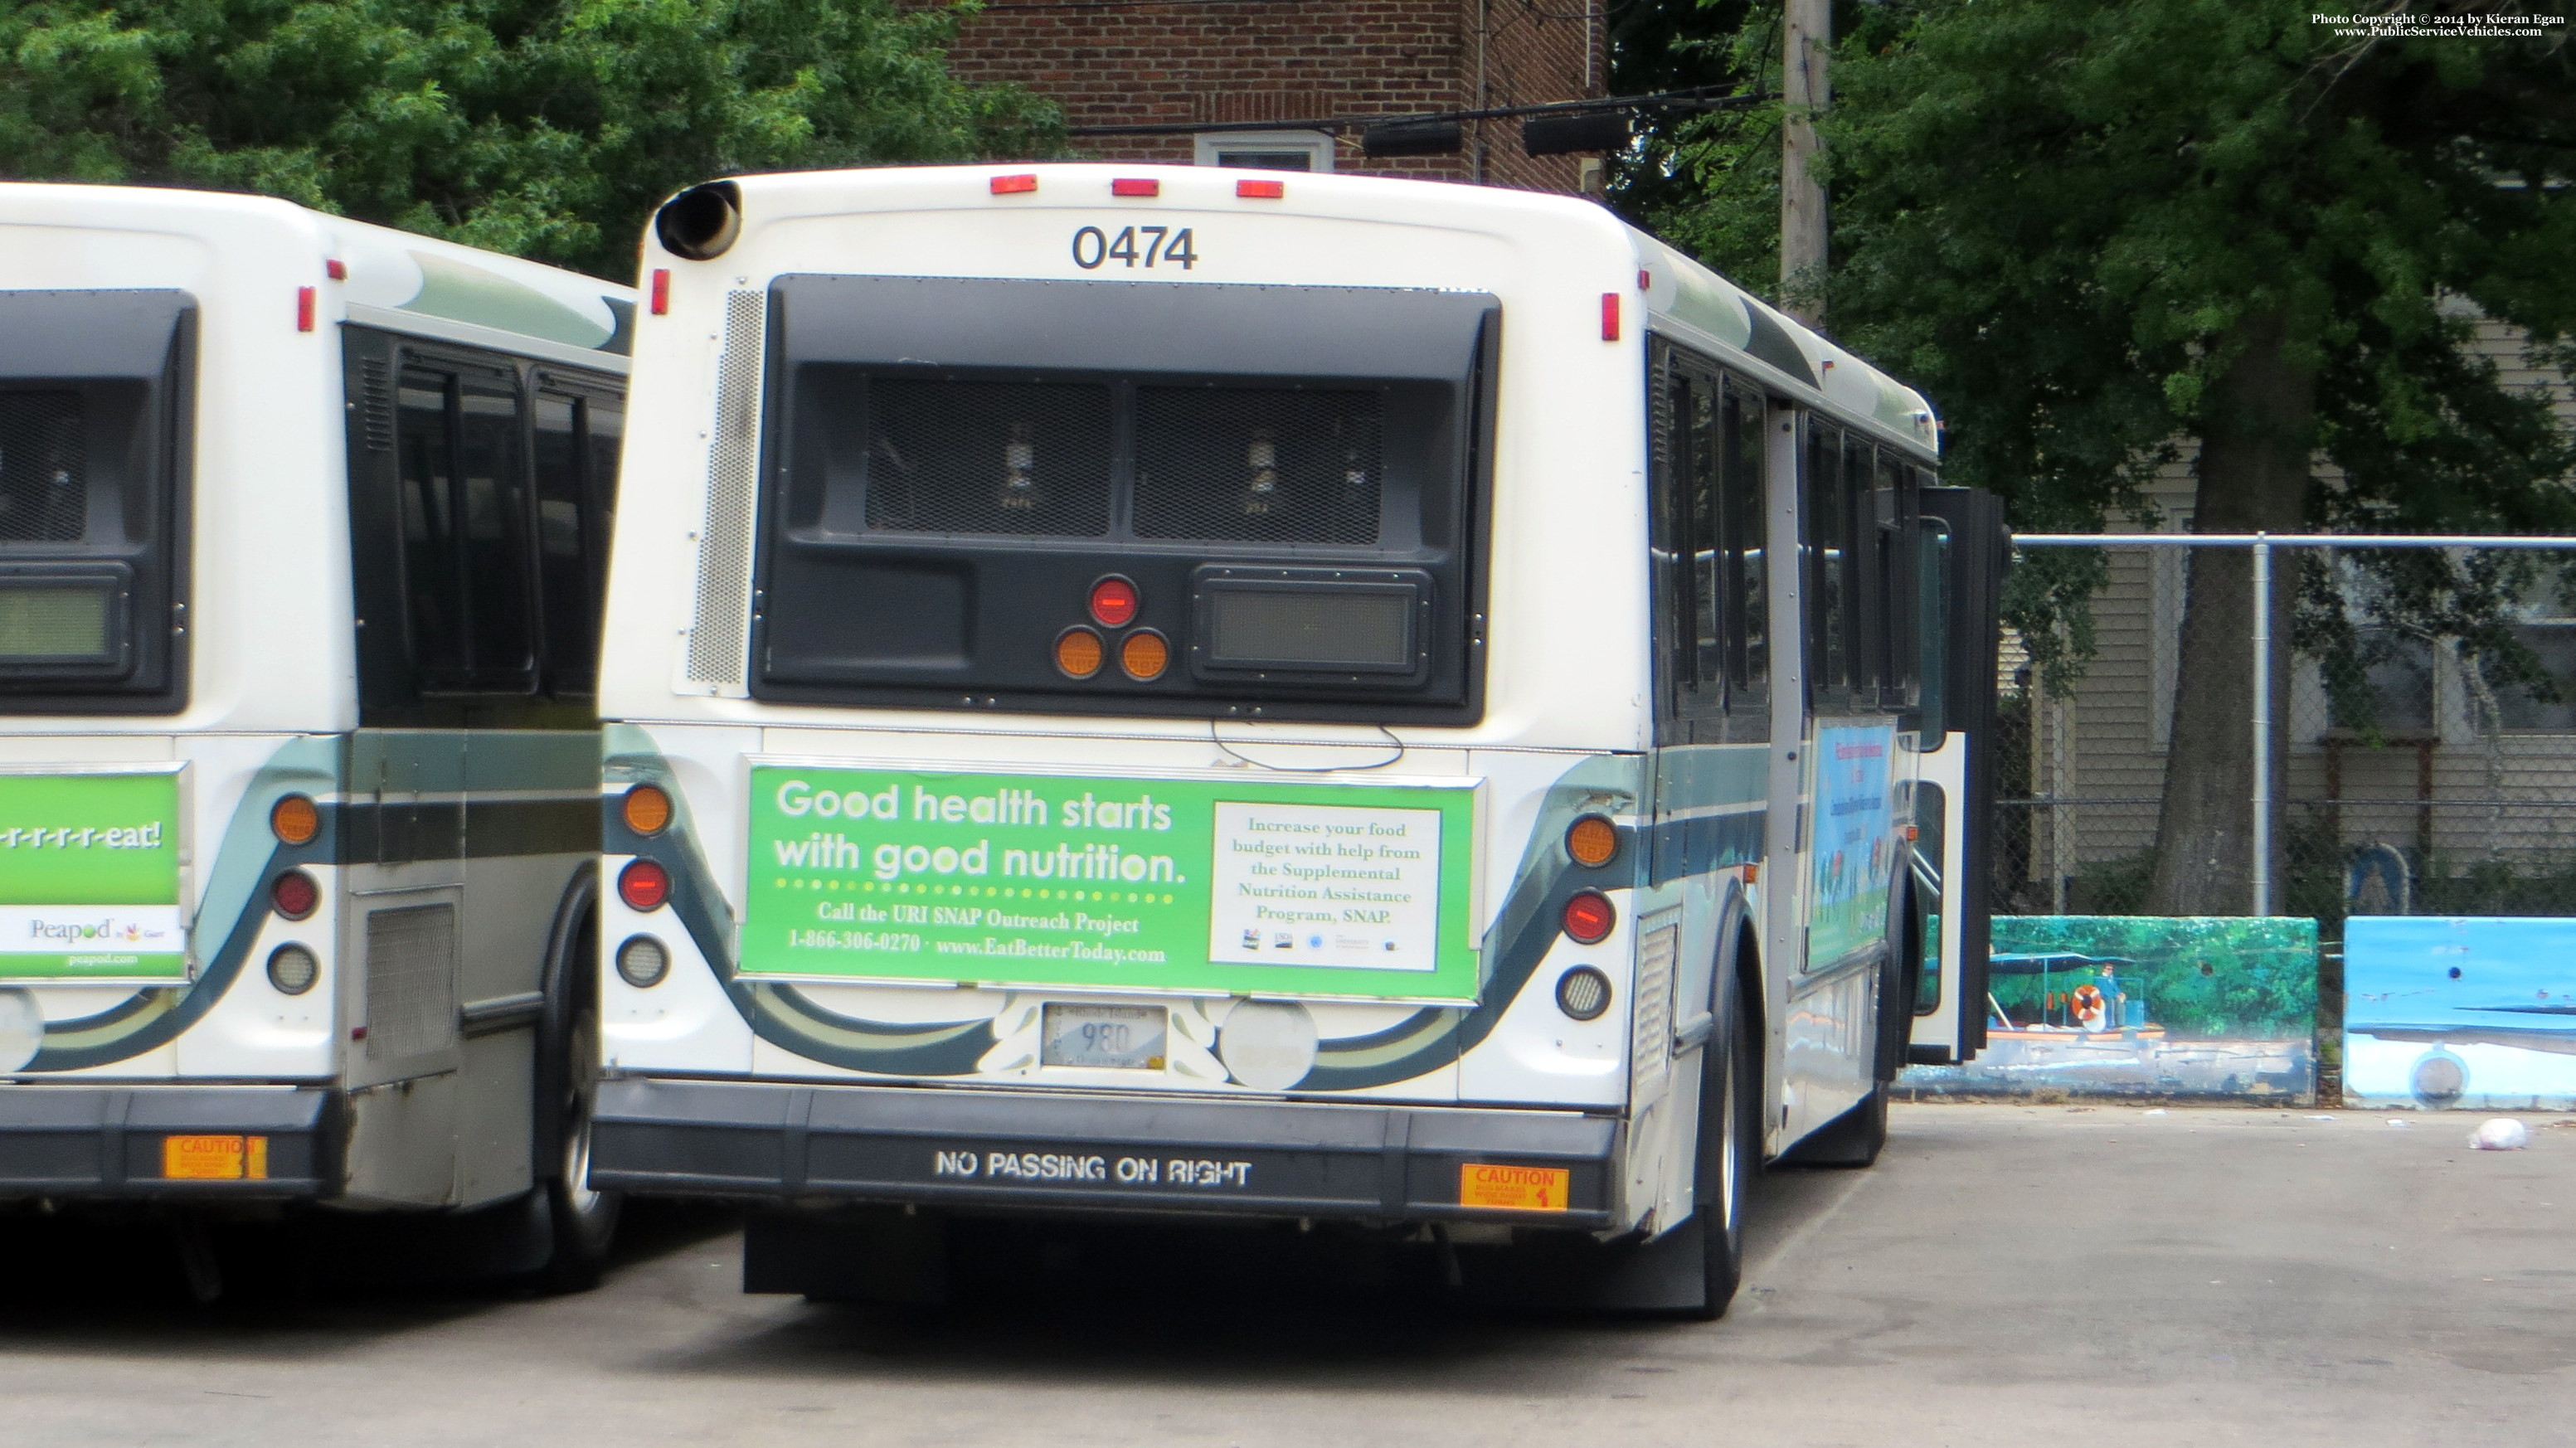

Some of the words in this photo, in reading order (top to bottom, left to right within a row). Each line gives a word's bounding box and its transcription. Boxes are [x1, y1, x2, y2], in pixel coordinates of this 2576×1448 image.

[1072, 226, 1198, 270] 0474
[777, 780, 899, 820] Good
[914, 785, 1047, 826] health
[1062, 792, 1172, 830] starts
[1248, 818, 1320, 833] Increase
[1325, 825, 1364, 838] your
[1368, 823, 1407, 837] food
[775, 833, 859, 869] with
[873, 839, 989, 880] good
[1004, 843, 1186, 883] nutrition.
[1232, 839, 1290, 856] budget
[1295, 842, 1333, 856] with
[1337, 843, 1374, 861] help
[1378, 845, 1421, 859] from
[1251, 862, 1278, 876] the
[1282, 862, 1401, 880] Supplemental
[1237, 882, 1318, 899] Nutrition
[1322, 886, 1412, 903] Assistance
[819, 901, 854, 921] Call
[858, 903, 887, 922] the
[893, 905, 928, 924] URI
[933, 906, 982, 926] SNAP
[987, 908, 1070, 930] Outreach
[1074, 912, 1140, 934] Project
[1256, 906, 1338, 924] Program,
[1343, 910, 1391, 924] SNAP.
[31, 918, 111, 944] Peapod
[790, 930, 921, 952] 1-866-306-0270
[936, 938, 1166, 963] www.EatBetterToday.com
[68, 954, 139, 966] peapod.com
[936, 1150, 979, 1176] NO
[987, 1151, 1106, 1181] PASSING
[1116, 1157, 1158, 1183] ON
[1168, 1159, 1252, 1187] RIGHT
[1475, 1168, 1555, 1187] CAUTION
